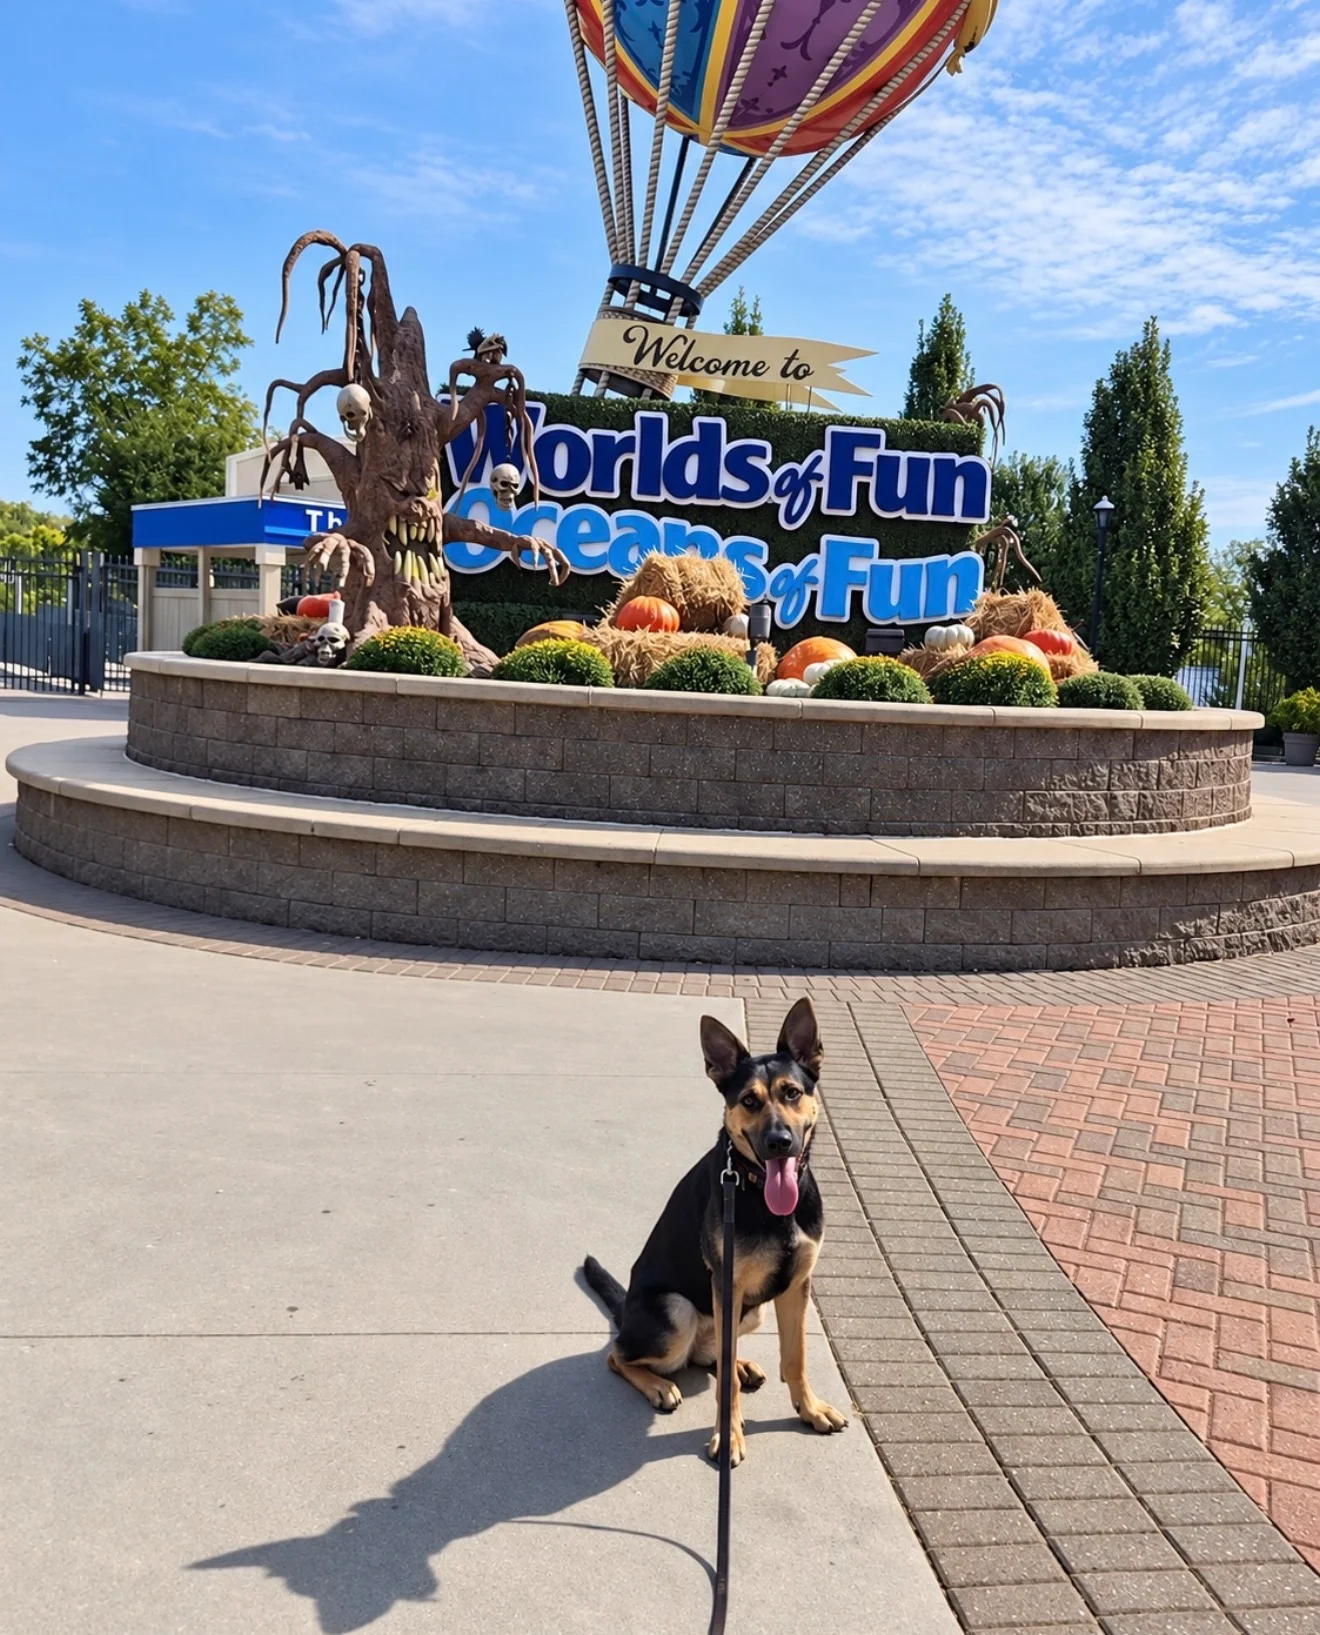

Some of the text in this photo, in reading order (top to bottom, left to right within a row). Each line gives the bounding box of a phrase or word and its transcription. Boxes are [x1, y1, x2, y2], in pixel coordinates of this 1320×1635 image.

[622, 324, 815, 381] Welcome to
[438, 396, 988, 526] Worlds of Fun
[769, 557, 820, 626] of
[820, 539, 981, 622] Fun
